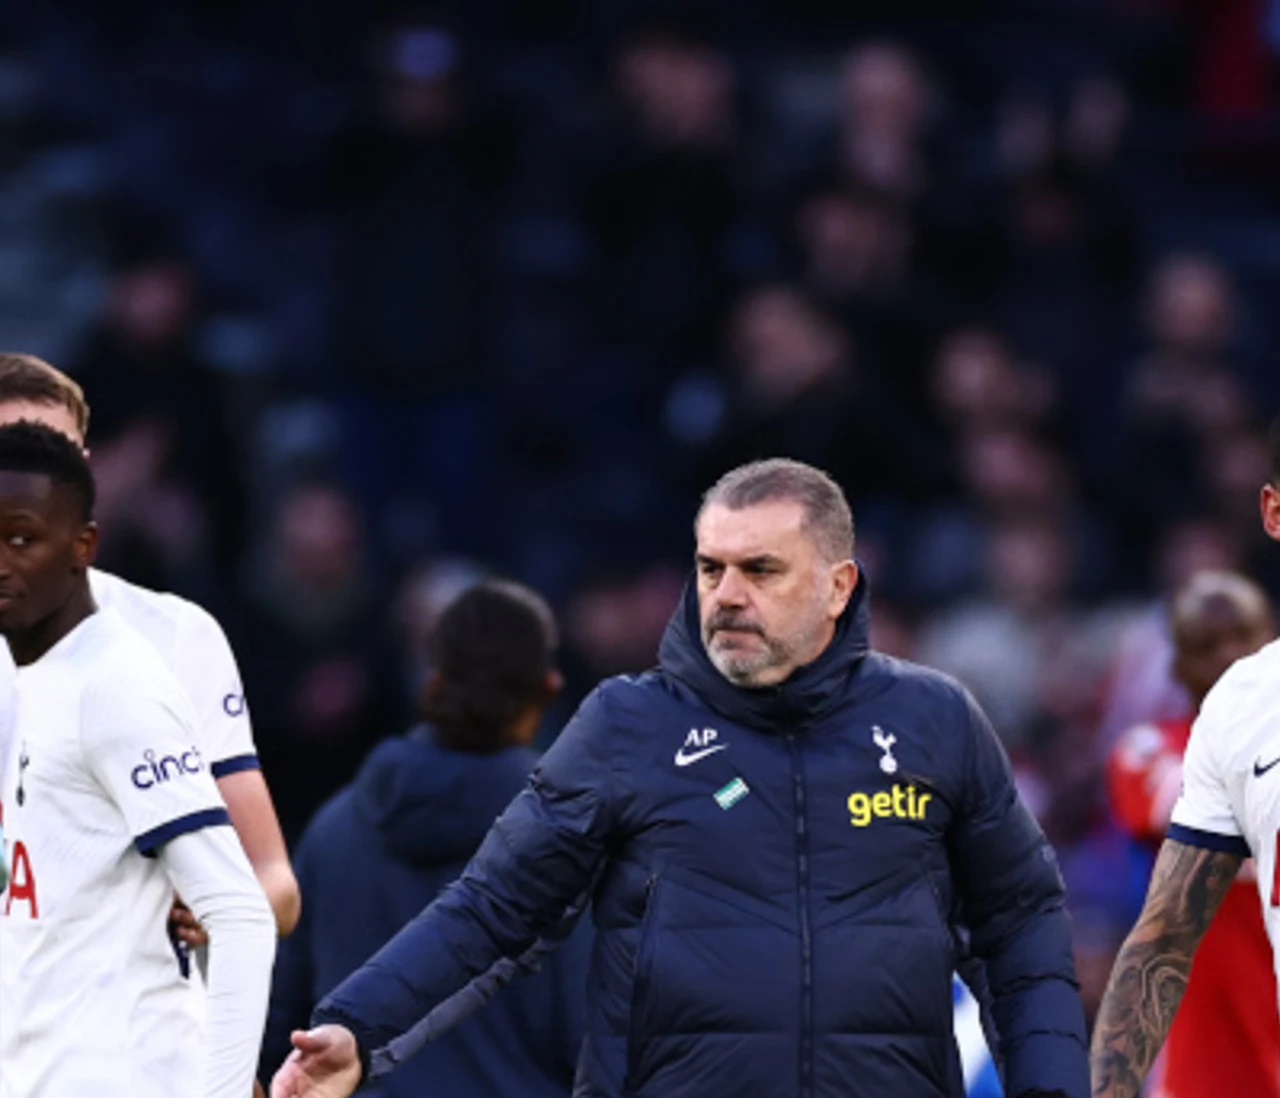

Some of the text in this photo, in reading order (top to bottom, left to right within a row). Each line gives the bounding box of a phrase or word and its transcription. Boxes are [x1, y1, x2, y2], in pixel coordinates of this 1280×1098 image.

[684, 728, 718, 747] AP
[131, 746, 206, 790] cinc
[847, 784, 932, 828] getir
